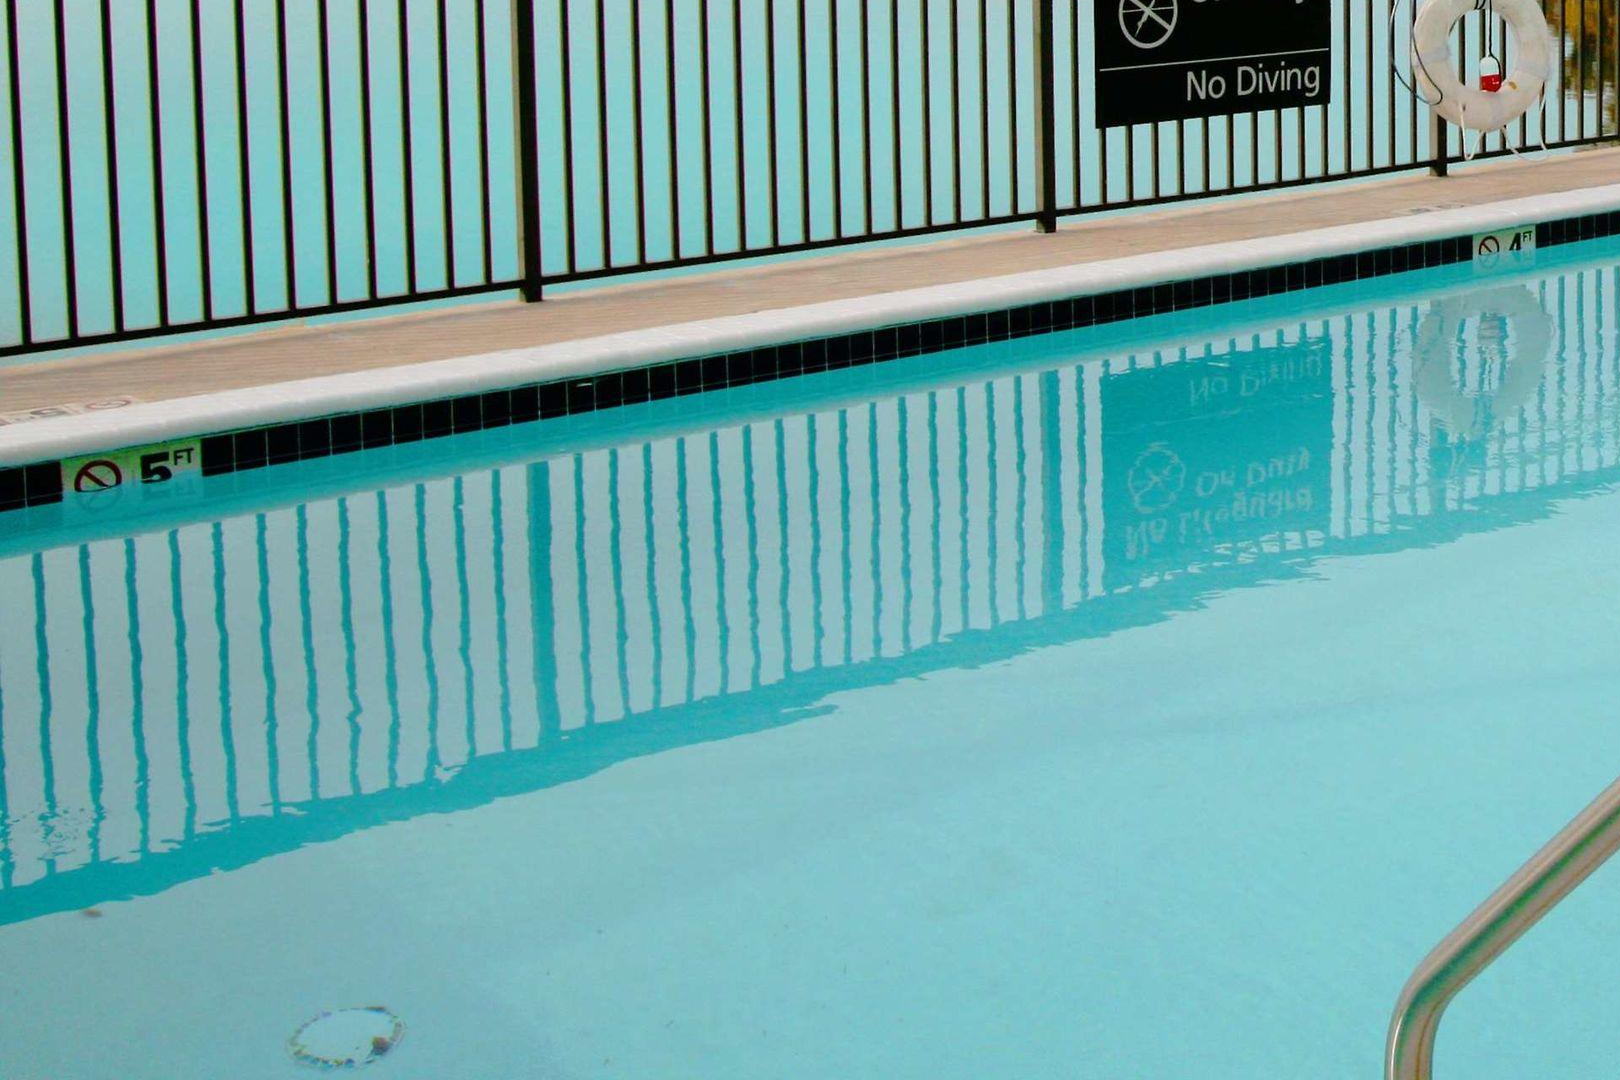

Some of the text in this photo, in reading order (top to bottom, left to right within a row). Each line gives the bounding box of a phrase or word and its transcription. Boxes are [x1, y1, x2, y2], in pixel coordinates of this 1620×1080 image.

[1186, 61, 1320, 101] No Diving
[140, 447, 195, 484] 5 FT
